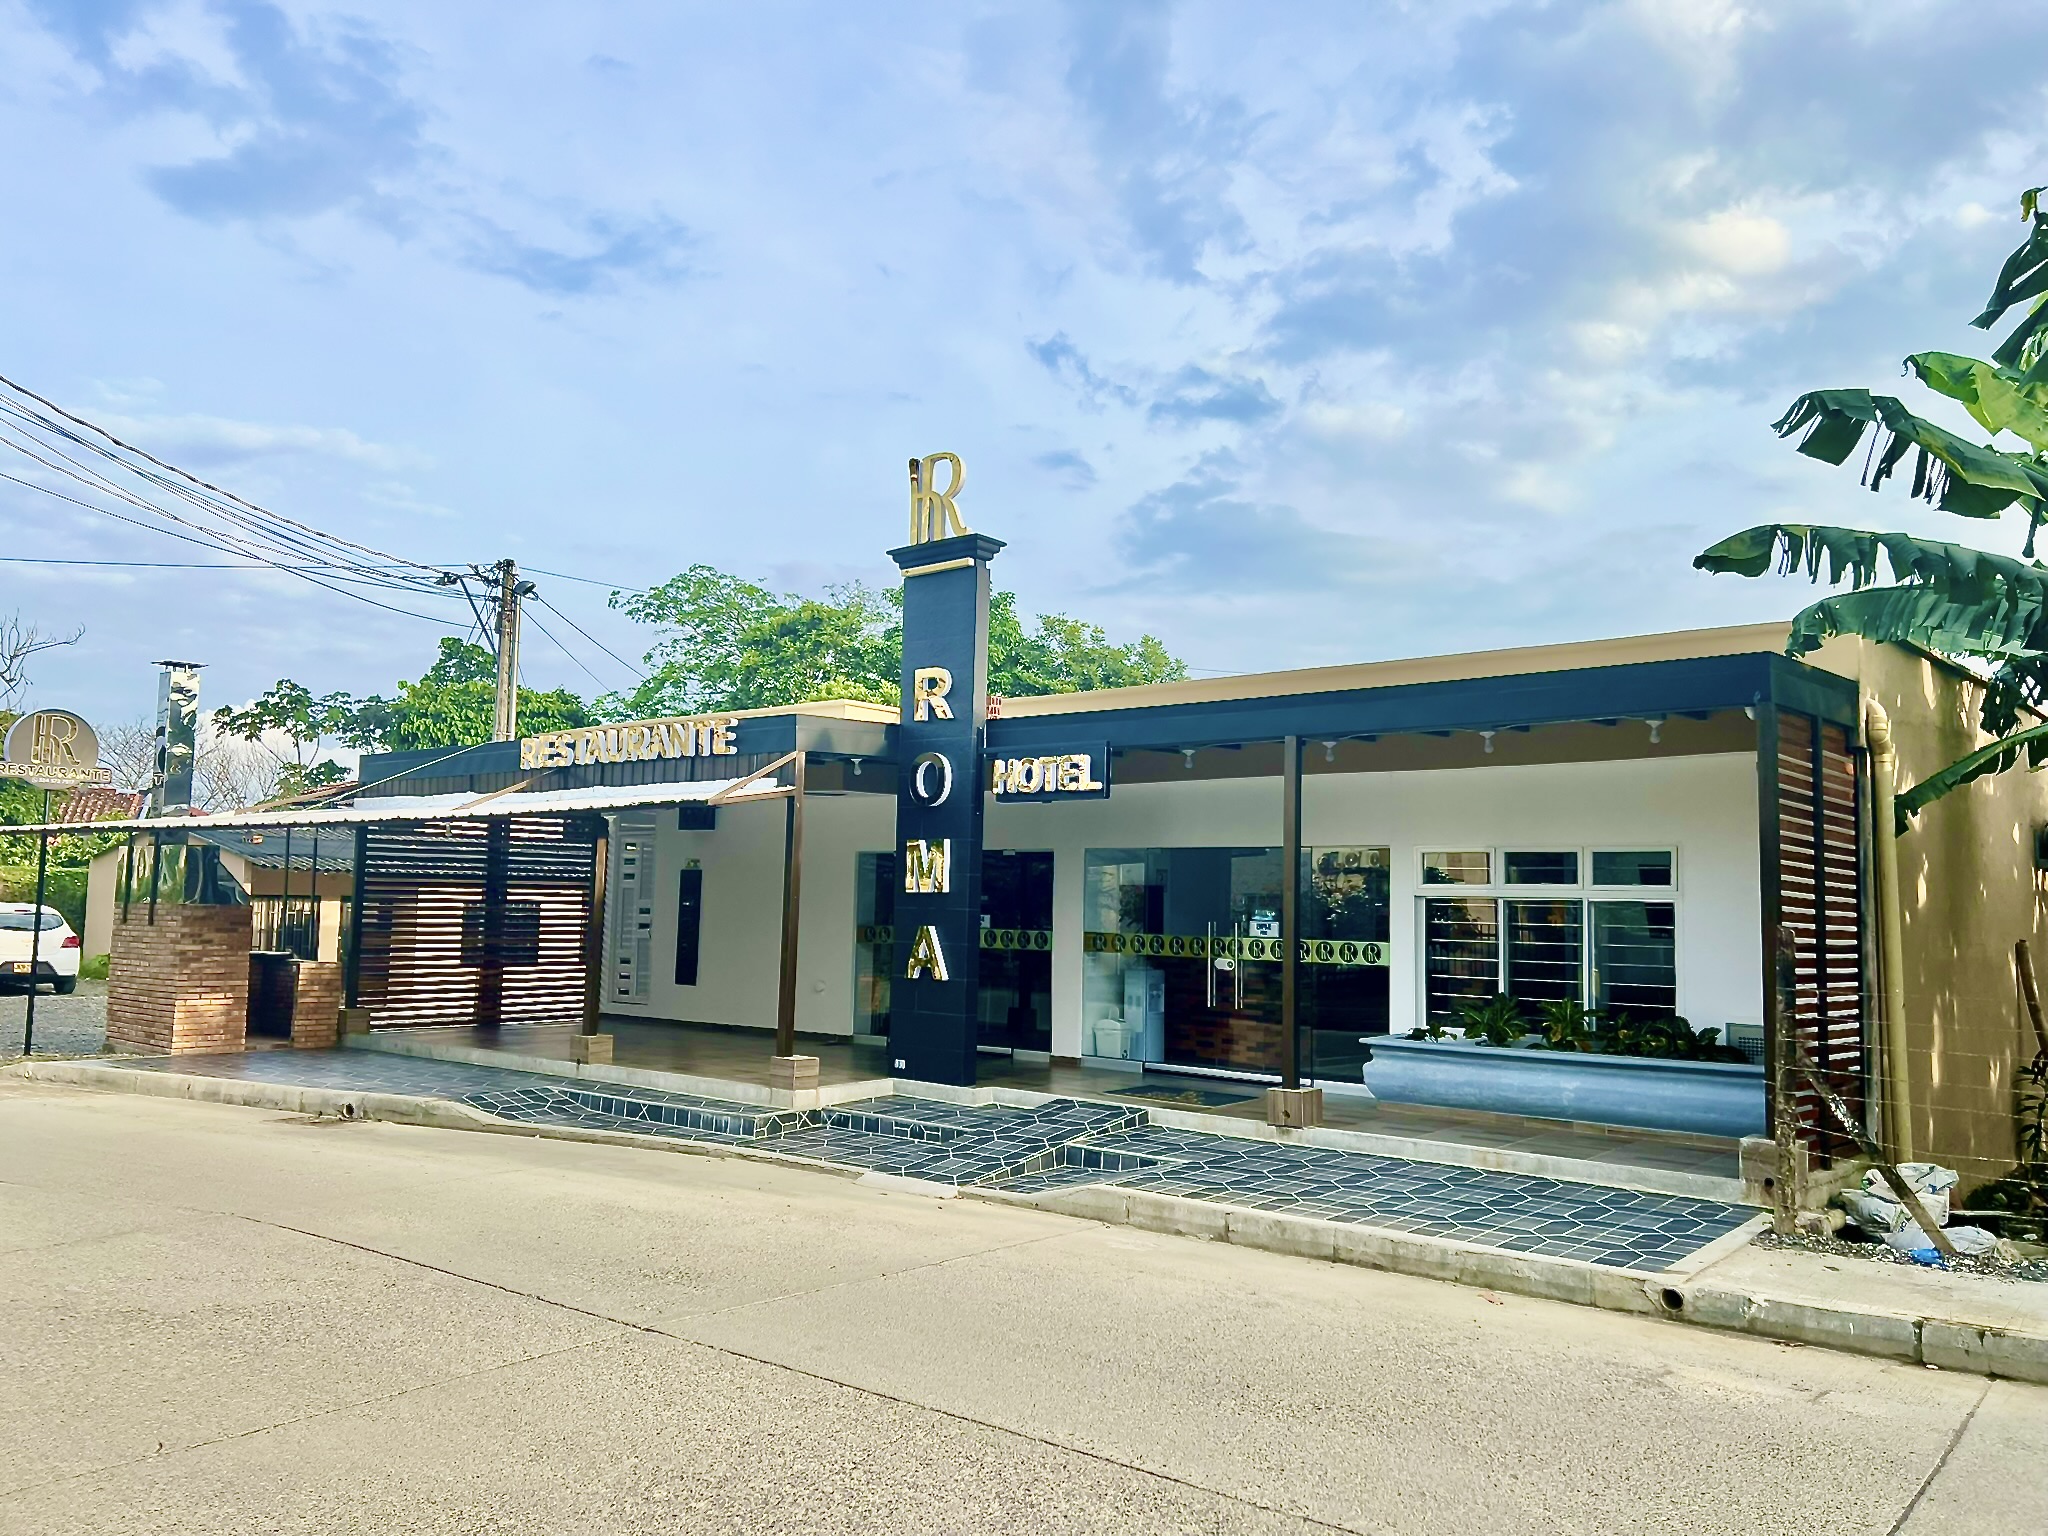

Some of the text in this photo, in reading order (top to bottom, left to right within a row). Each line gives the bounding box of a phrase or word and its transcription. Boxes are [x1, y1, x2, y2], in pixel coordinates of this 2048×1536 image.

[520, 717, 738, 770] RESTAURANTE
[0, 763, 111, 782] RESTAURANTE
[992, 754, 1102, 794] HOTEL
[905, 667, 954, 981] ROMA
